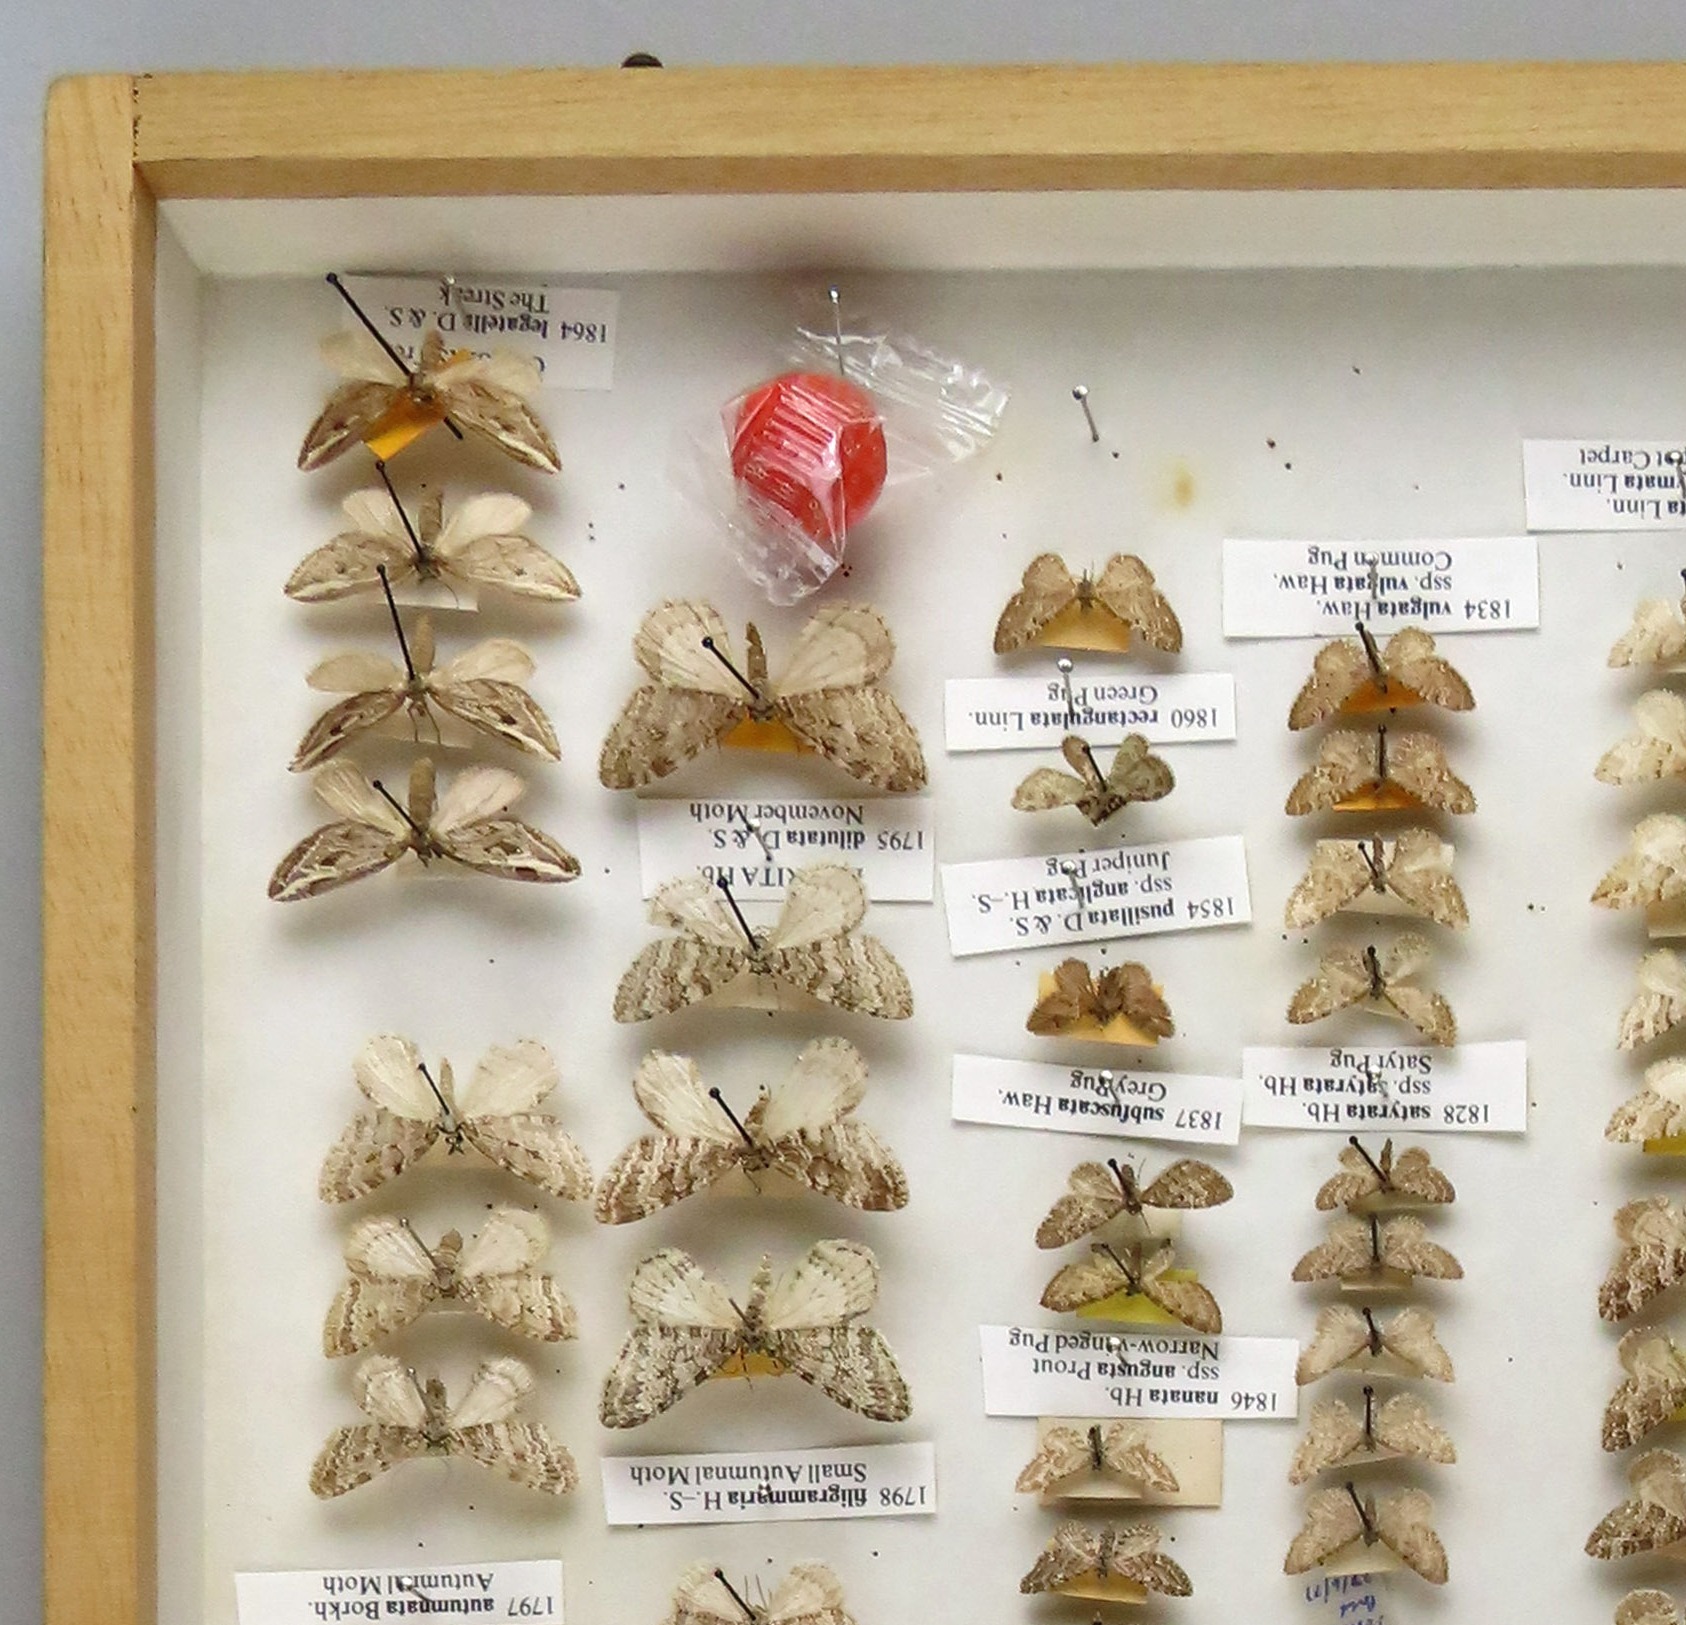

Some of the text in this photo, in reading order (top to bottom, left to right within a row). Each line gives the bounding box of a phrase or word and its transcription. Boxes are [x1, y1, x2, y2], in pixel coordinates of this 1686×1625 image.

[1580, 445, 1650, 470] Carpet
[1564, 473, 1617, 493] Linn.
[1607, 499, 1661, 519] Linn.
[1308, 546, 1347, 571] Pug
[1274, 574, 1327, 595] Haw.
[1317, 600, 1509, 624] 1834 Haw.
[1094, 685, 1158, 705] Green
[969, 708, 1216, 731] 1860 Linn.
[686, 800, 867, 828] November Moth
[787, 826, 922, 850] 1795 dilutata
[1093, 850, 1170, 873] Juniper
[1088, 897, 1233, 926] 1854 pusillata
[1327, 1045, 1373, 1076] Pug
[1260, 1076, 1296, 1096] Hb.
[999, 1090, 1221, 1130] 1837 Haw.
[1303, 1100, 1488, 1124] 1828 satyrata Hb.
[1010, 1327, 1050, 1353] Pug
[1033, 1359, 1091, 1380] Prout
[1106, 1387, 1276, 1411] 1846 nanata Hb.
[630, 1463, 866, 1485] Small Autumnal Moth
[728, 1484, 925, 1510] 1798 filigrammaria
[323, 1576, 381, 1595] Moth
[309, 1597, 553, 1621] 1797 Borkh.
